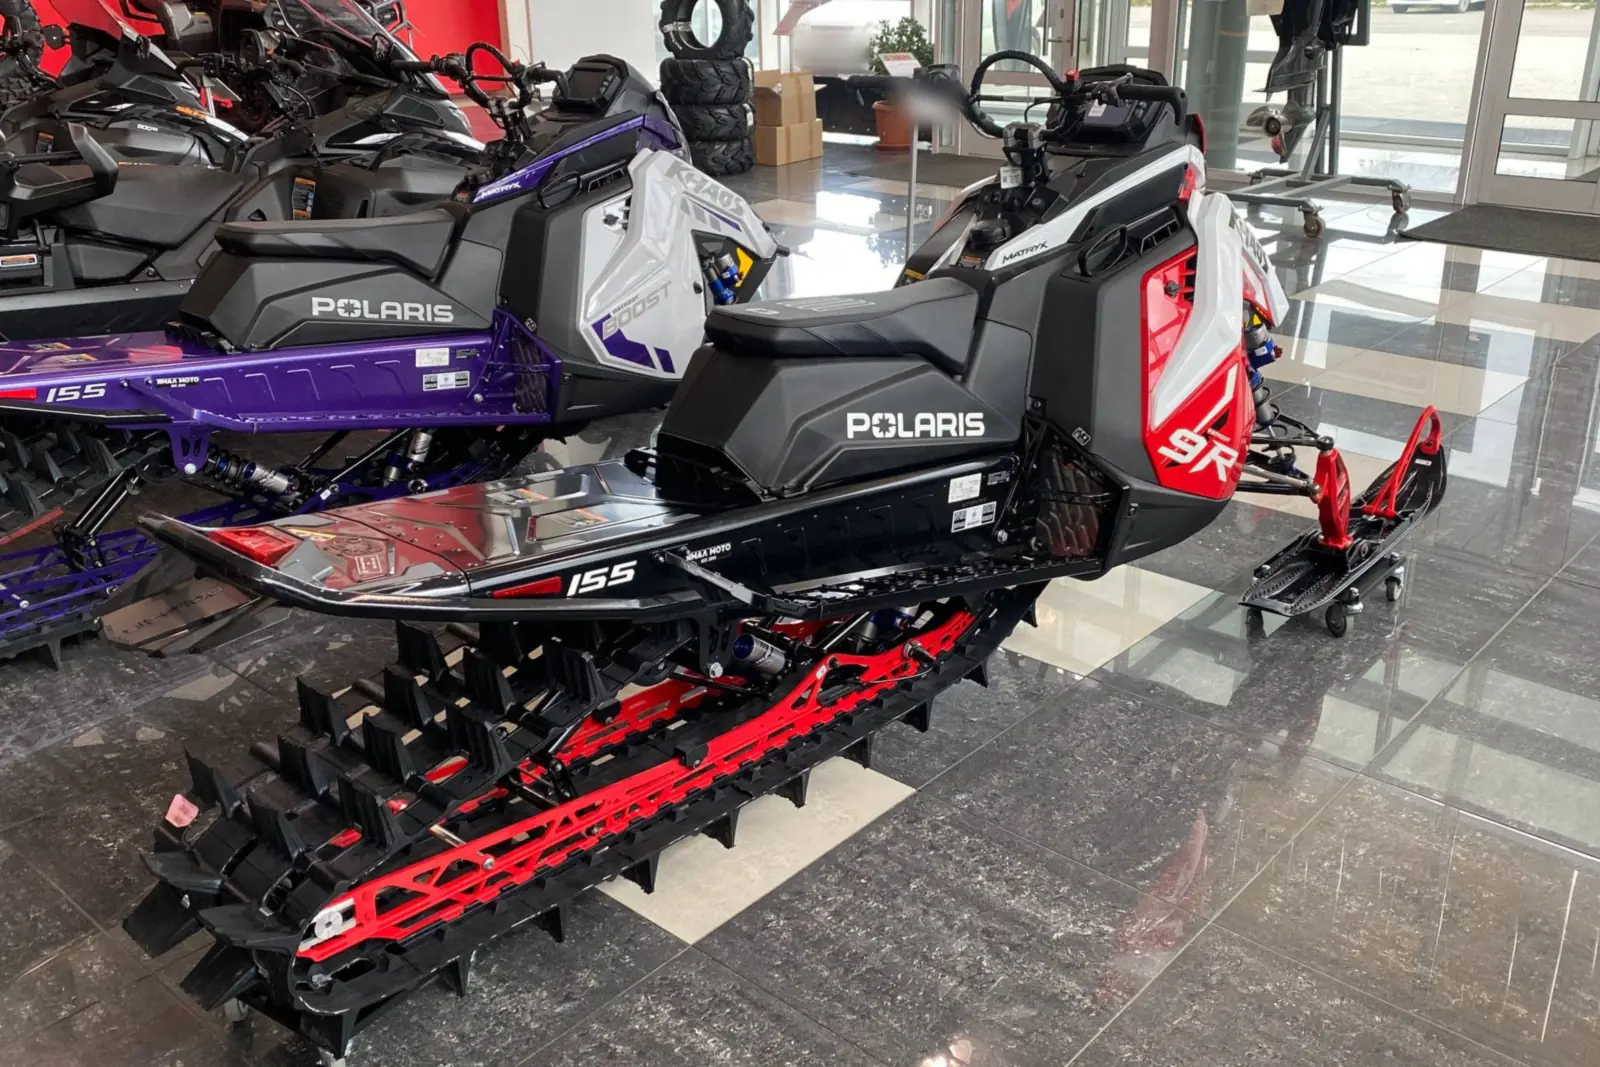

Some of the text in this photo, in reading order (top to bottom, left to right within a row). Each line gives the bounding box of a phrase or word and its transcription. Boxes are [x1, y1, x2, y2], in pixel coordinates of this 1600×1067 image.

[1002, 241, 1048, 264] MATRYX
[311, 297, 454, 323] POLARIS
[602, 280, 672, 340] BOOST
[46, 382, 107, 403] 155
[846, 412, 985, 439] POLARIS
[1157, 428, 1239, 483] 9R
[566, 560, 638, 597] 155
